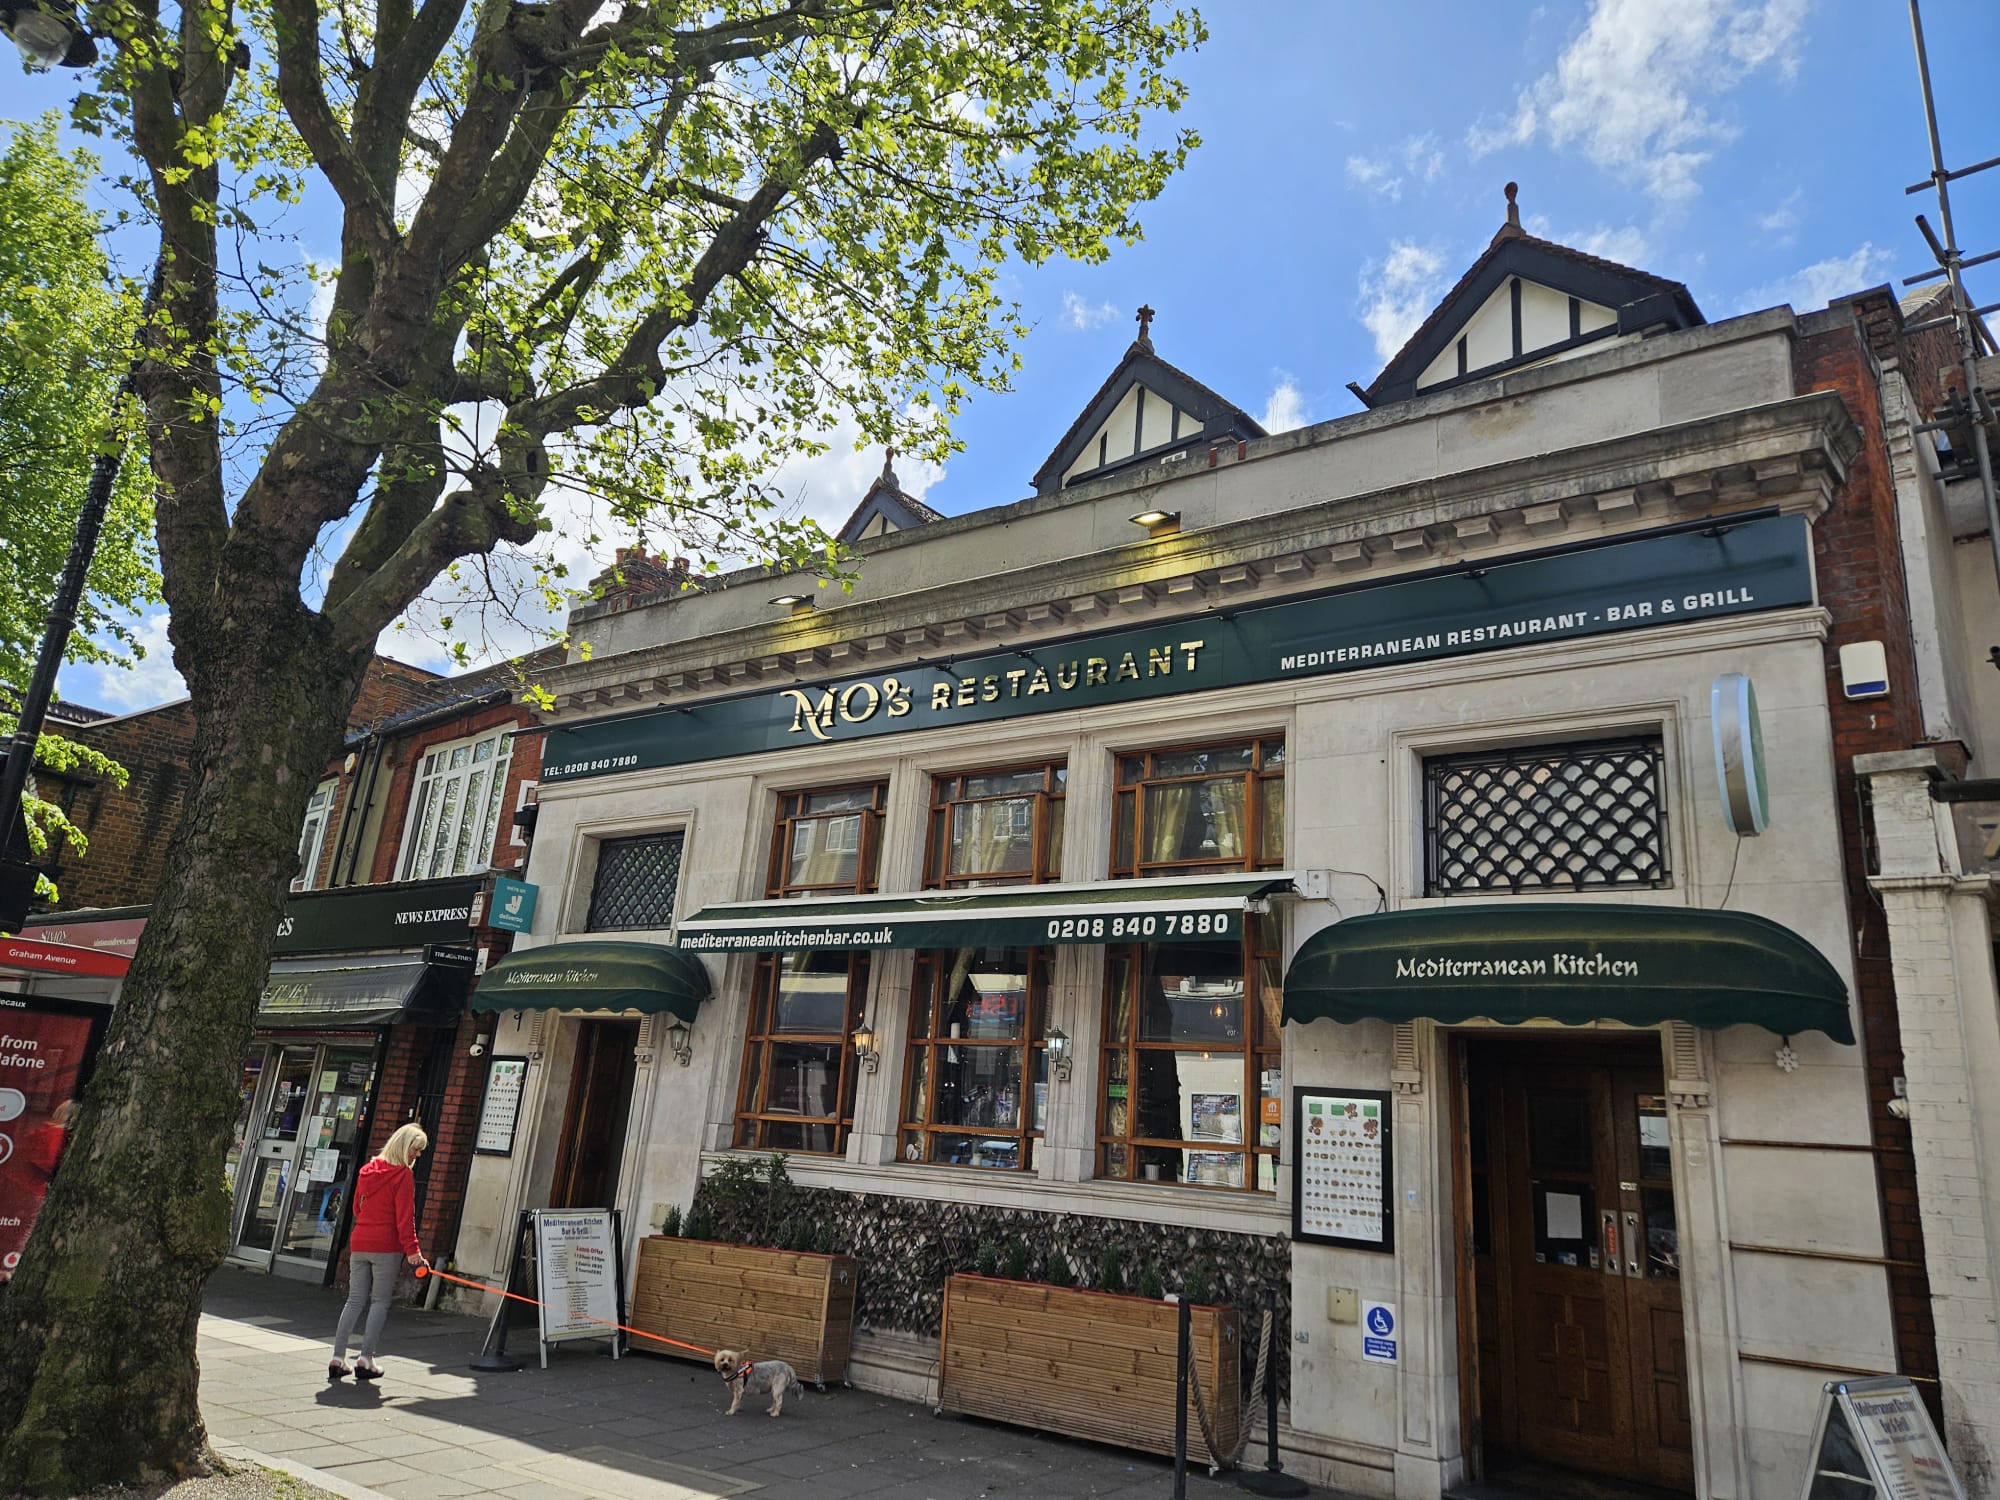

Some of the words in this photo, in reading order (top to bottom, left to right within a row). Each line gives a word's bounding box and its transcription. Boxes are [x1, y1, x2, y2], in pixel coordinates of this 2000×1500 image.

[1281, 634, 1440, 670] MEDITERRANEAN
[1447, 612, 1587, 645] RESTAURANT
[1607, 602, 1653, 622] BAR
[1660, 599, 1675, 613] &
[1683, 587, 1754, 610] GRILL
[931, 639, 1205, 711] RESTAURANT
[544, 767, 563, 777] TEL:
[564, 762, 589, 774] 0208
[591, 759, 610, 771] 840
[612, 755, 638, 767] 7880
[394, 911, 424, 925] NEWS
[424, 907, 469, 922] EXPRESS
[498, 912, 524, 923] deliveroo
[1047, 918, 1104, 939] 0208
[1111, 916, 1156, 936] 840
[1165, 913, 1229, 935] 7880
[680, 927, 893, 949] mediterraneankitchenbar.co.uk
[8, 948, 43, 960] Graham
[44, 953, 77, 965] Avenue
[1395, 957, 1546, 978] Mediterranean
[1553, 952, 1639, 977] Kitchen
[505, 970, 563, 985] Mediterranean
[564, 968, 599, 984] Kitchen
[0, 1034, 38, 1051] from
[0, 1052, 45, 1069] afone
[544, 1218, 583, 1227] Mediterranean
[583, 1217, 603, 1225] Kitchen
[561, 1227, 571, 1235] Bar
[576, 1227, 588, 1235] Grill
